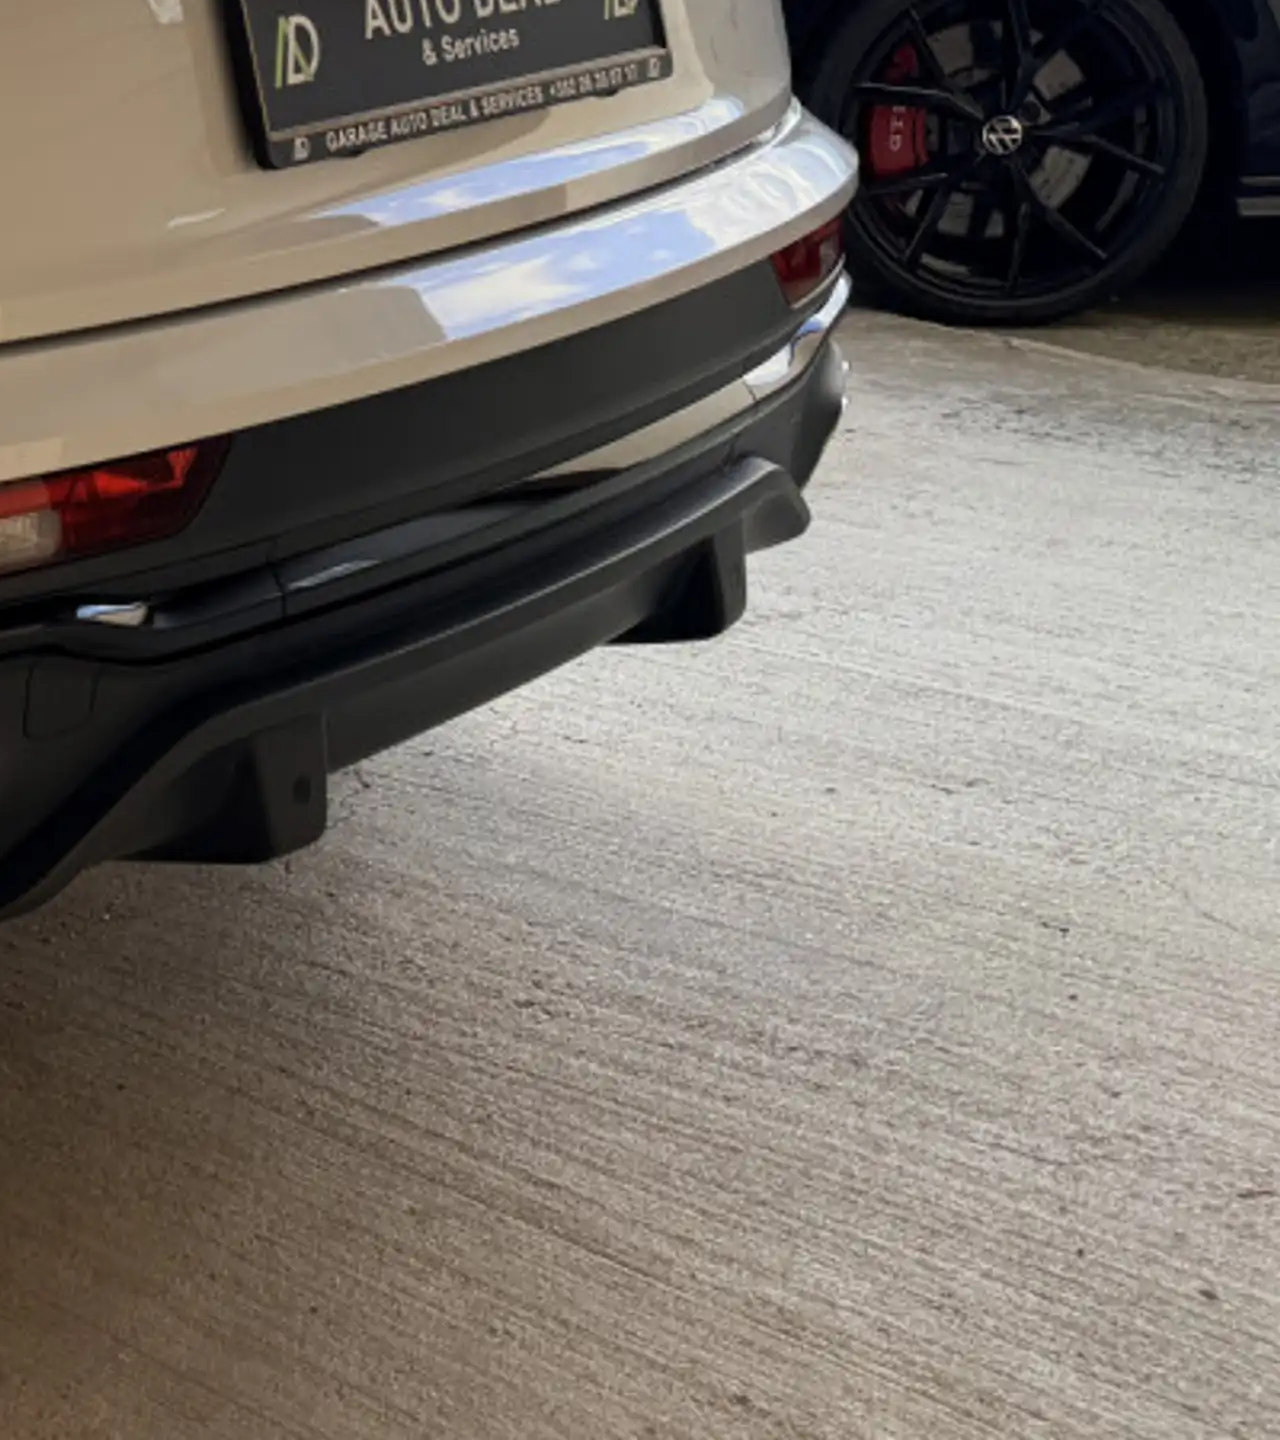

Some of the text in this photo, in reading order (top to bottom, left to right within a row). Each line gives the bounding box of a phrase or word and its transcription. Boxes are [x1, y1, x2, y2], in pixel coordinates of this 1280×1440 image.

[422, 28, 520, 66] & Services
[325, 120, 388, 152] GARAGE
[390, 110, 428, 137] AUTO
[429, 102, 467, 128] DEAL
[481, 84, 544, 114] SERVICES
